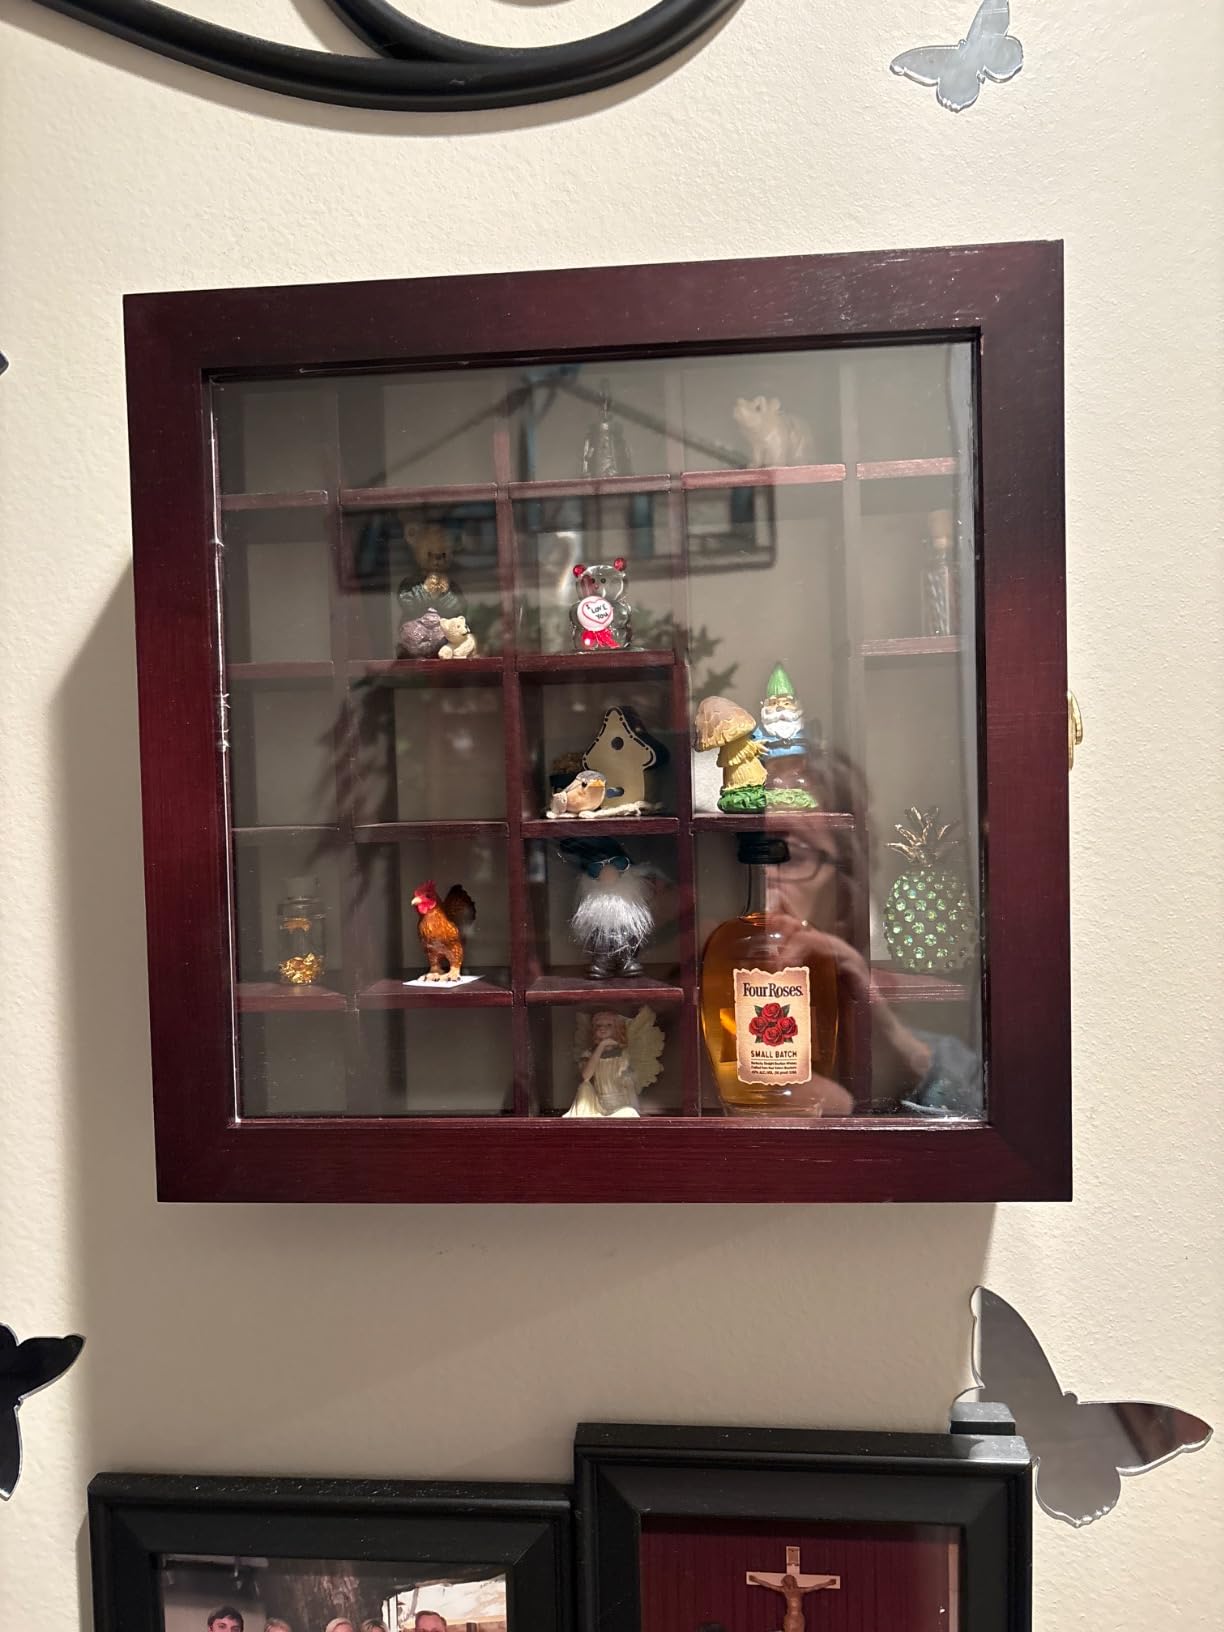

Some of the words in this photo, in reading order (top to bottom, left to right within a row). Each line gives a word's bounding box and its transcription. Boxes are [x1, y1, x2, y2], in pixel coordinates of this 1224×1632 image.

[591, 603, 608, 614] LOVE
[743, 982, 768, 997] Four
[751, 1050, 773, 1058] SMALL
[775, 1050, 797, 1058] BATCH
